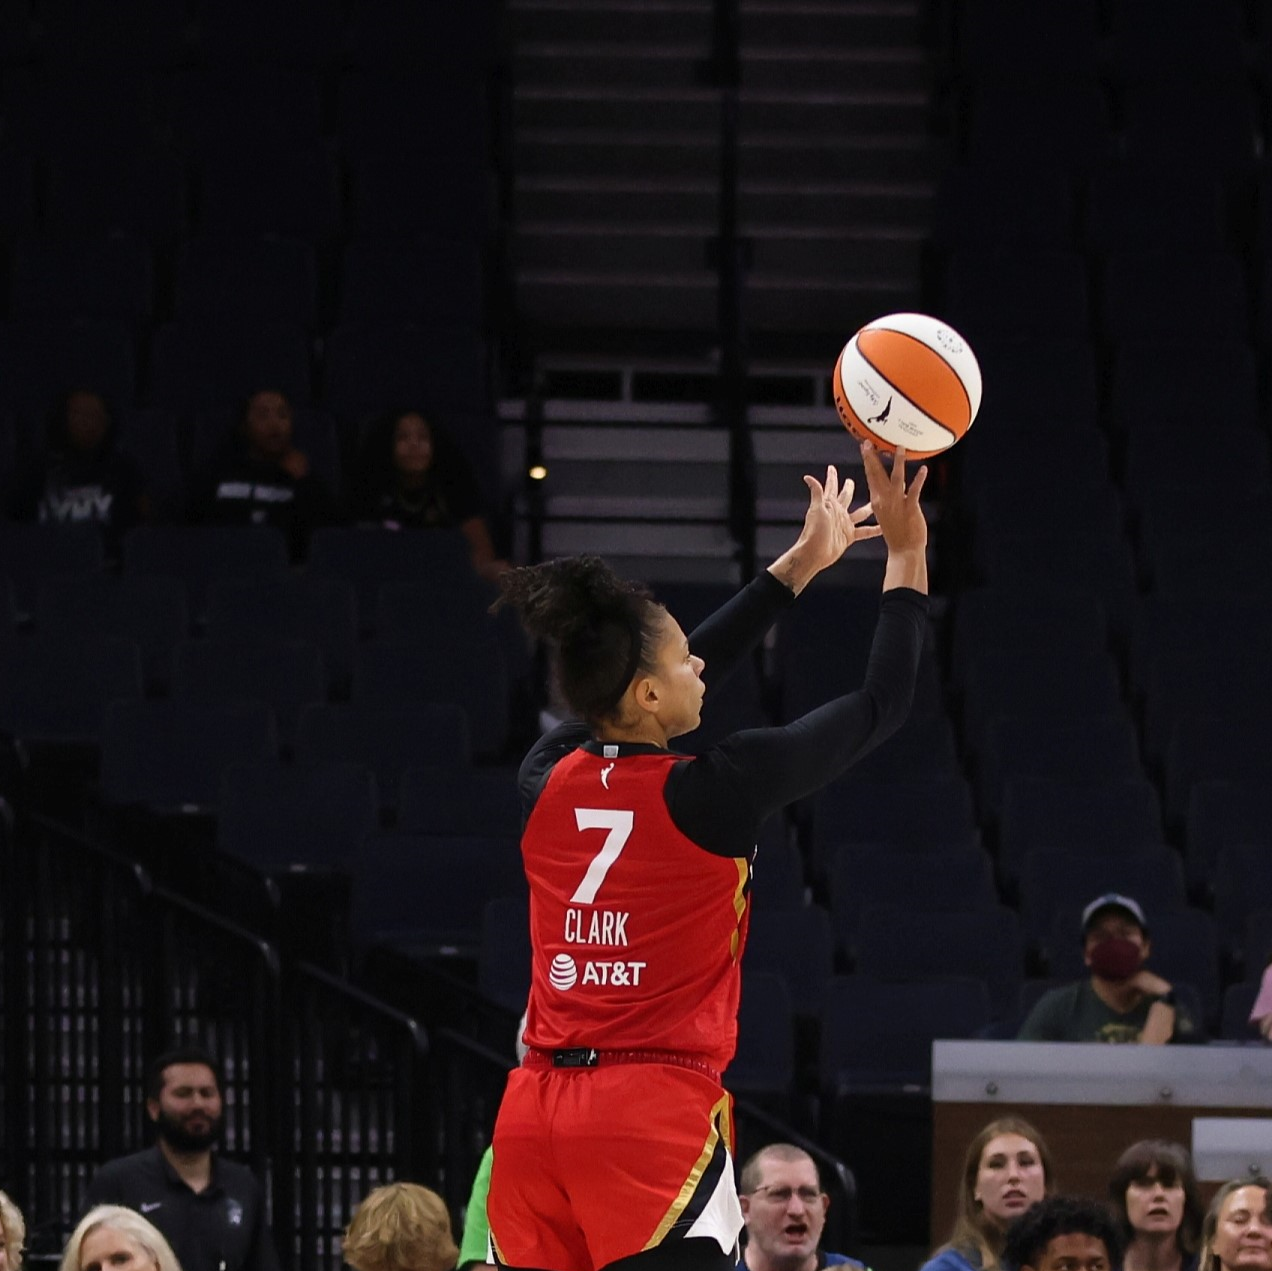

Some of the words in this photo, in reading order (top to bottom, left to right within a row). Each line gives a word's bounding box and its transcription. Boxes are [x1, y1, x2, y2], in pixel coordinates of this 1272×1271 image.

[570, 808, 634, 905] 7
[565, 908, 630, 947] CLARK
[581, 961, 647, 987] AT&T
